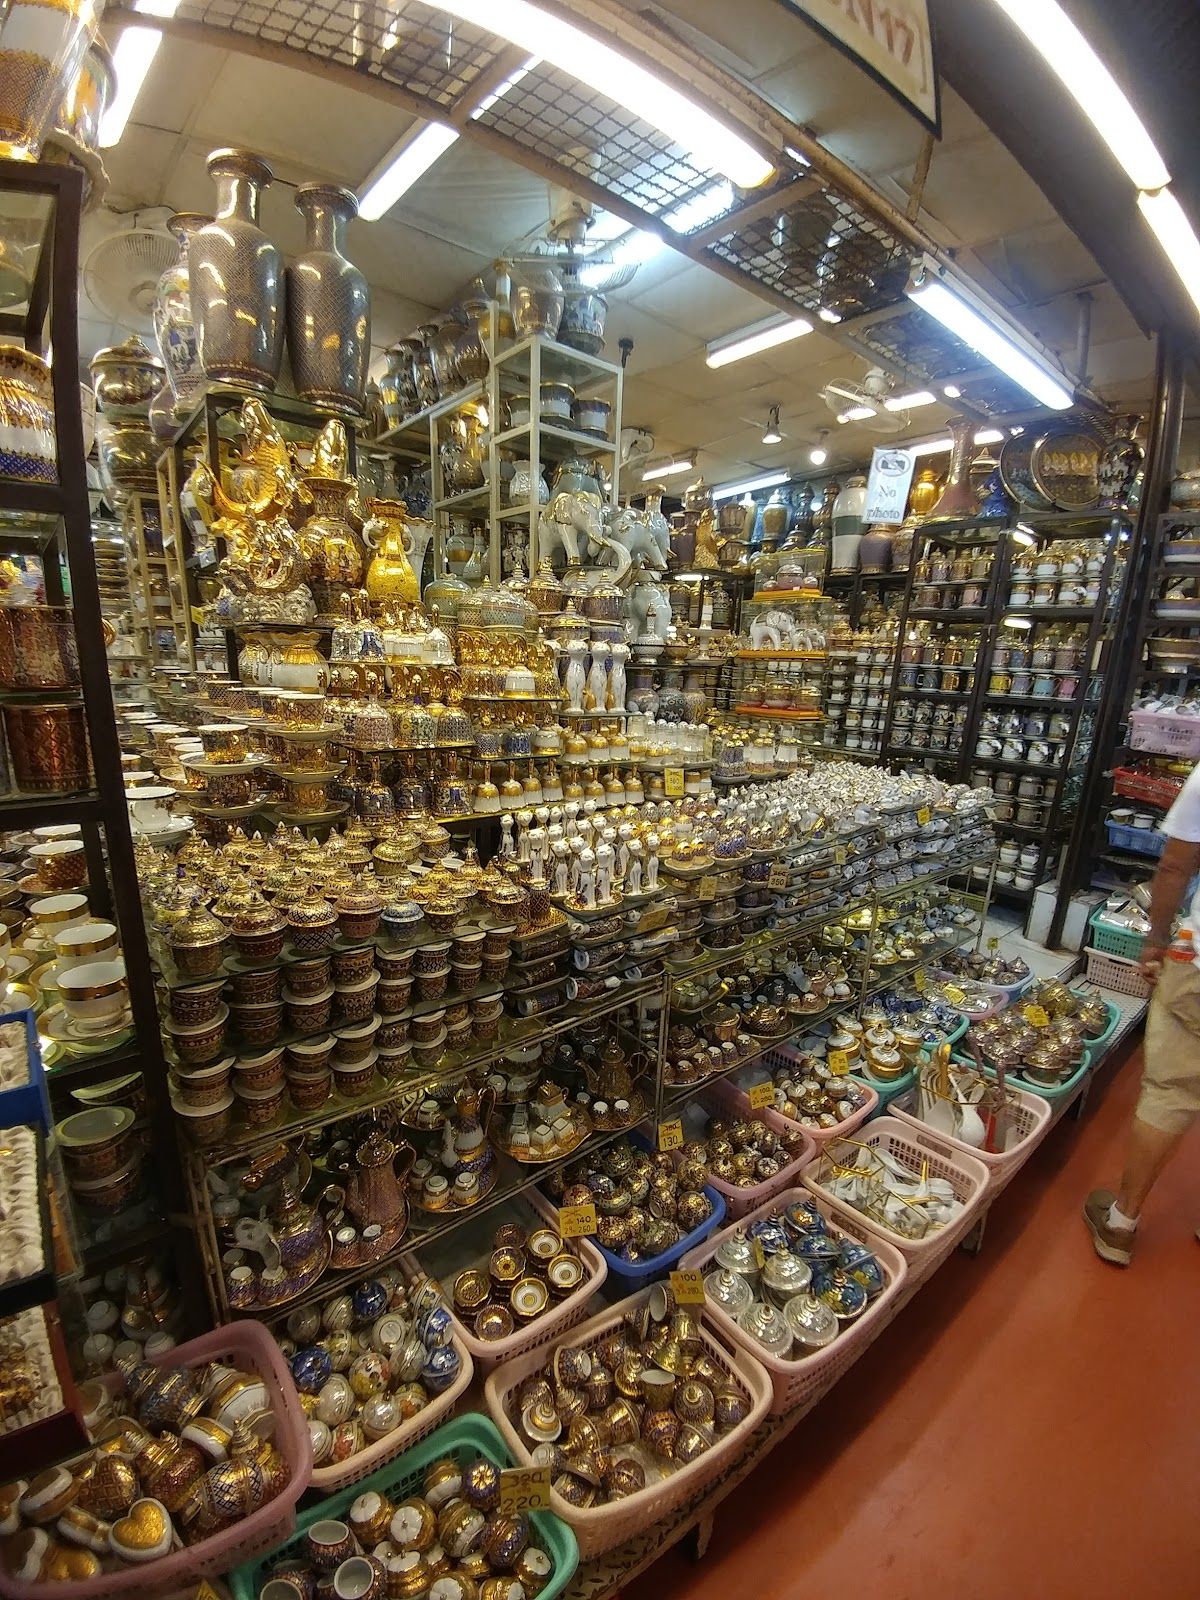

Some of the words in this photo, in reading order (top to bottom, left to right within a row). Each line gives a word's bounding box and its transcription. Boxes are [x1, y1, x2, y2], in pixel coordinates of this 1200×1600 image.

[879, 485, 896, 498] No
[866, 507, 900, 520] photo
[770, 878, 785, 886] 350
[680, 1273, 697, 1282] 100
